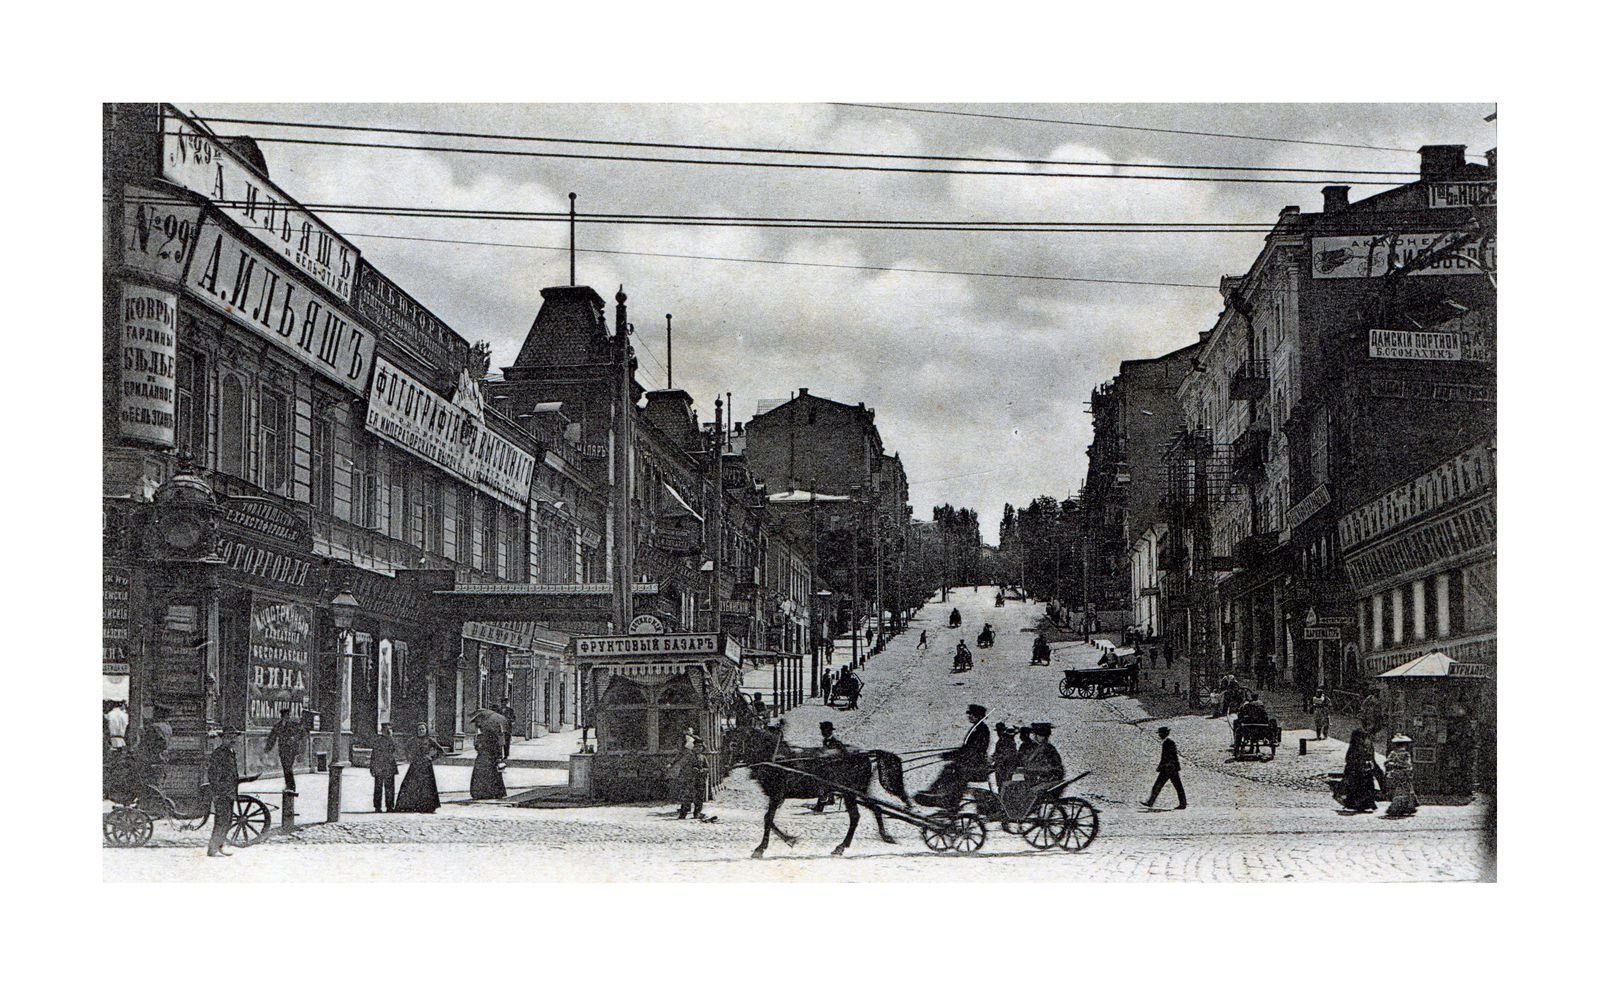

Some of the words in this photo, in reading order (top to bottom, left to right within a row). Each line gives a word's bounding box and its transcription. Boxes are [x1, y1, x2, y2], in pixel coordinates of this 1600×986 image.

[124, 296, 174, 330] КОВРЫ
[126, 325, 173, 347] ГАРДИНЫ
[1371, 330, 1412, 348] ДАМСКІЙ
[1415, 332, 1458, 350] ПОРТНОЙ
[375, 366, 460, 445] ФОТОГРАФІЯ
[580, 638, 660, 653] ФРУКТОВЫЙ
[663, 637, 714, 651] БАЗАРЪ
[254, 665, 305, 690] ВИНА
